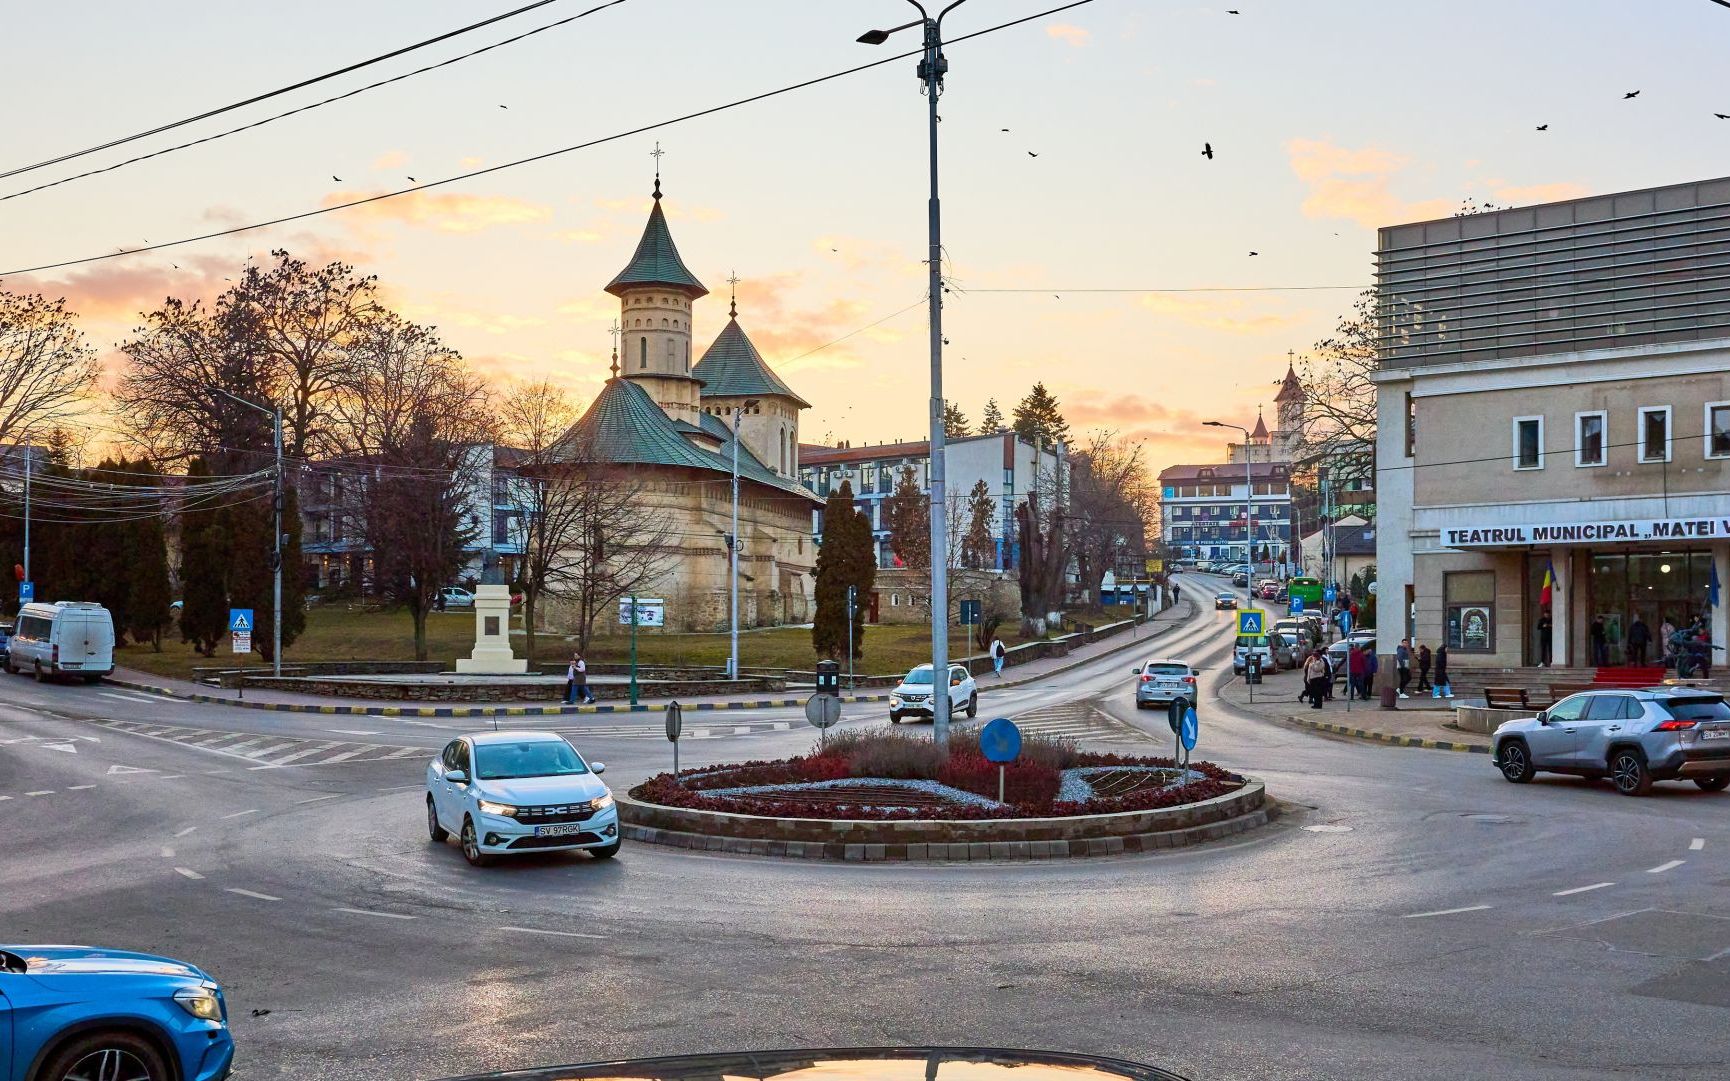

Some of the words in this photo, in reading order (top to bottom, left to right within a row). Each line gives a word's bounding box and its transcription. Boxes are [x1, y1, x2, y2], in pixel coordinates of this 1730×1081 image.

[1448, 528, 1526, 544] TEATRUL
[1533, 523, 1640, 541] MUNICIPAL
[1293, 598, 1300, 608] P
[540, 827, 551, 835] SV
